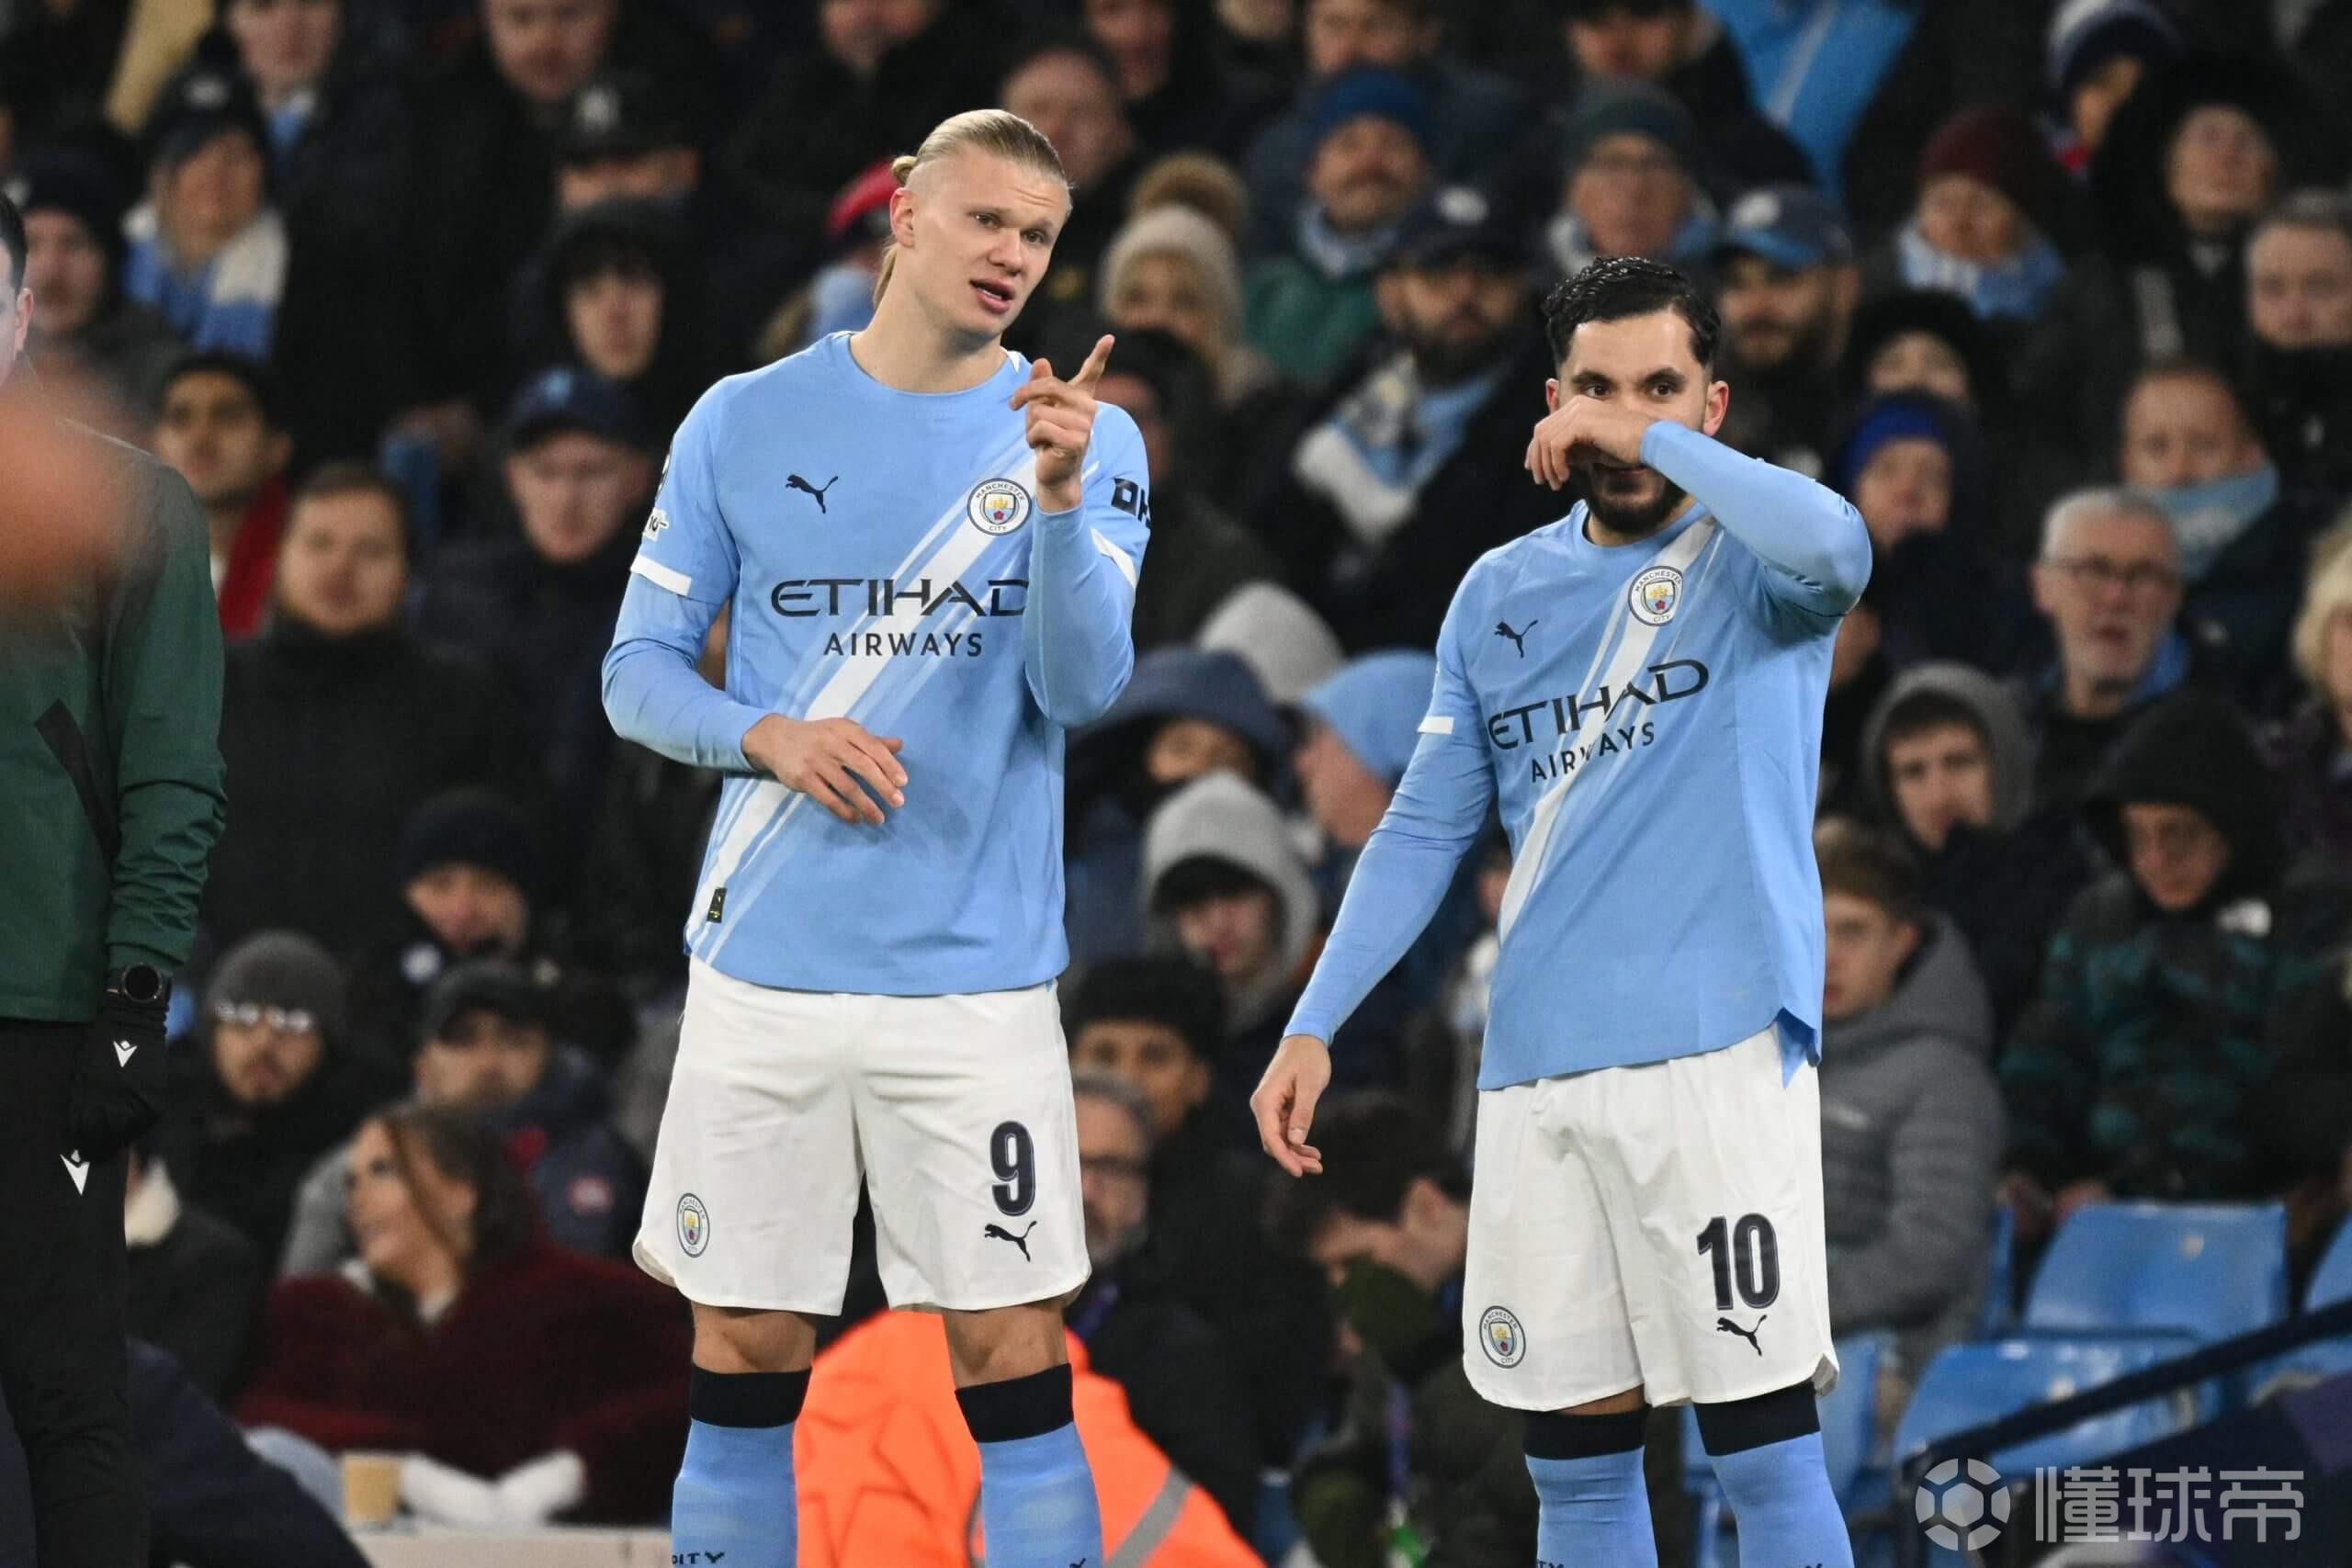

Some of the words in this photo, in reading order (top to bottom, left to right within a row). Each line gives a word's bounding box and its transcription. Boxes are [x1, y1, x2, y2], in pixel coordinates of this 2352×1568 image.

[976, 482, 1025, 501] MANCHESTER
[1635, 570, 1681, 592] MANCHESTER
[771, 579, 1029, 616] ETIHAD
[1654, 615, 1669, 623] CITY
[822, 632, 983, 657] AIRWAYS
[1487, 659, 1710, 750] ETIHAD
[989, 1120, 1036, 1217] 9
[1696, 1213, 1781, 1311] 10
